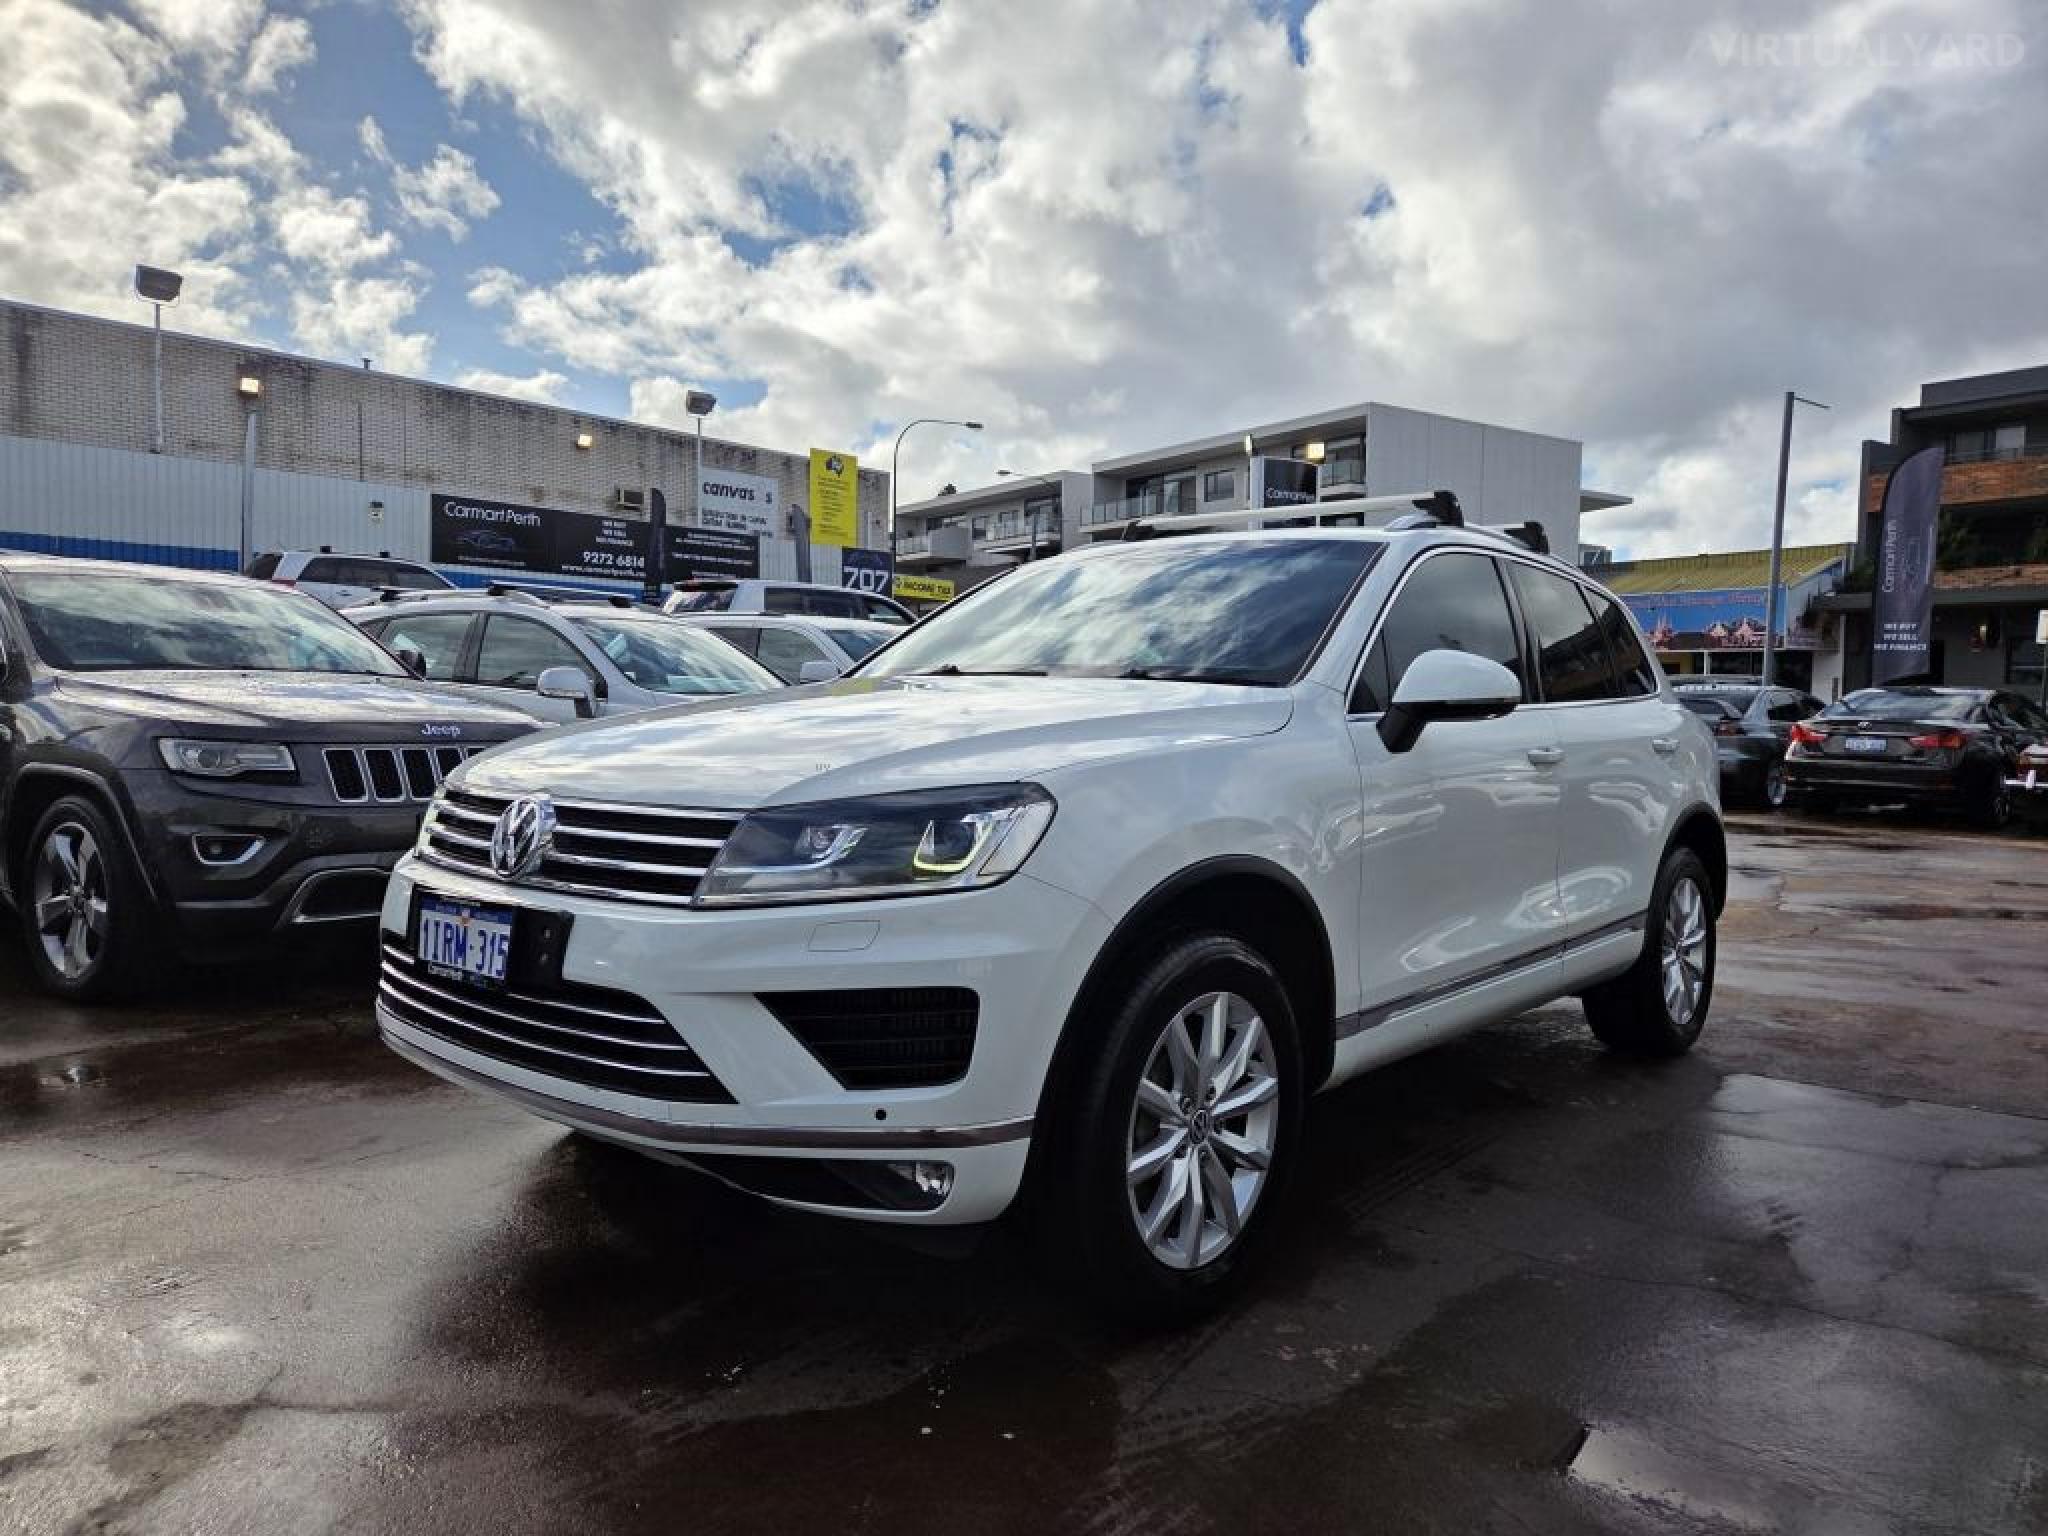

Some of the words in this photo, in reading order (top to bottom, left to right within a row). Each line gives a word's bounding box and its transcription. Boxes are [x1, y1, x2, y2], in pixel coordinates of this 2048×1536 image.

[583, 551, 613, 565] 9272
[843, 565, 889, 593] 707
[421, 723, 461, 739] Jeep
